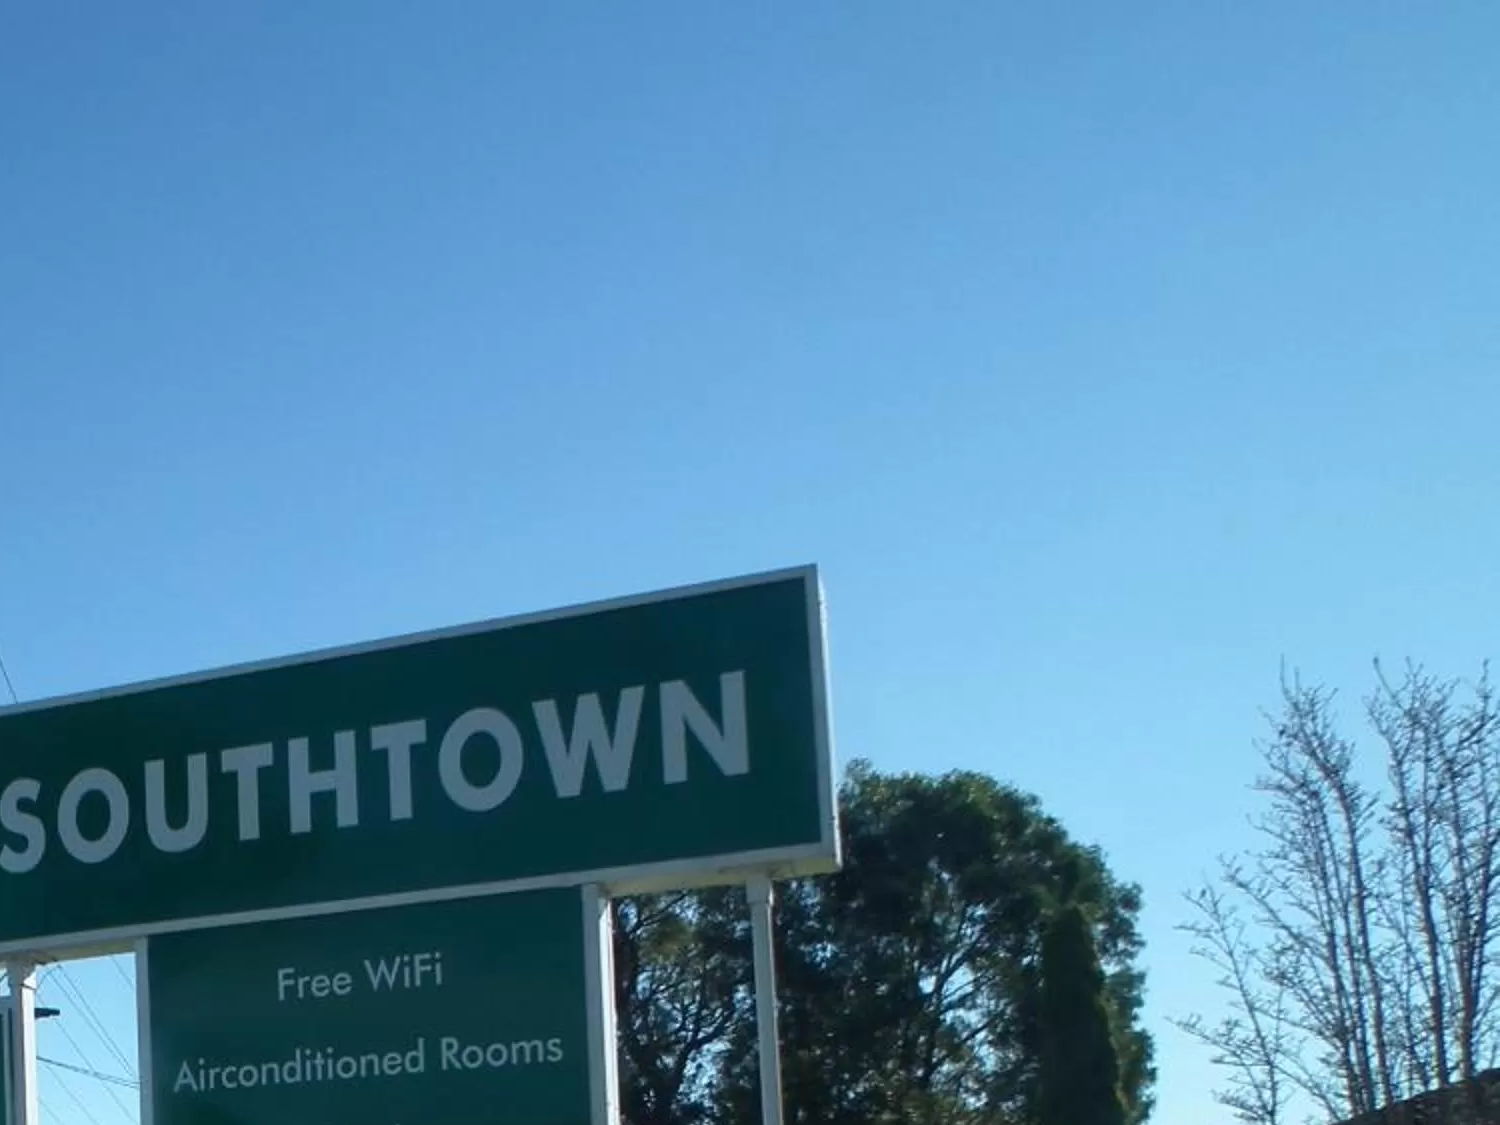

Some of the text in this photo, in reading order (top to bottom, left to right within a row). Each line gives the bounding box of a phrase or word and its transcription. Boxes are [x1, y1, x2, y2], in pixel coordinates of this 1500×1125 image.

[277, 952, 443, 1000] Free WiFi
[174, 1036, 564, 1092] Airconditioned Rooms
